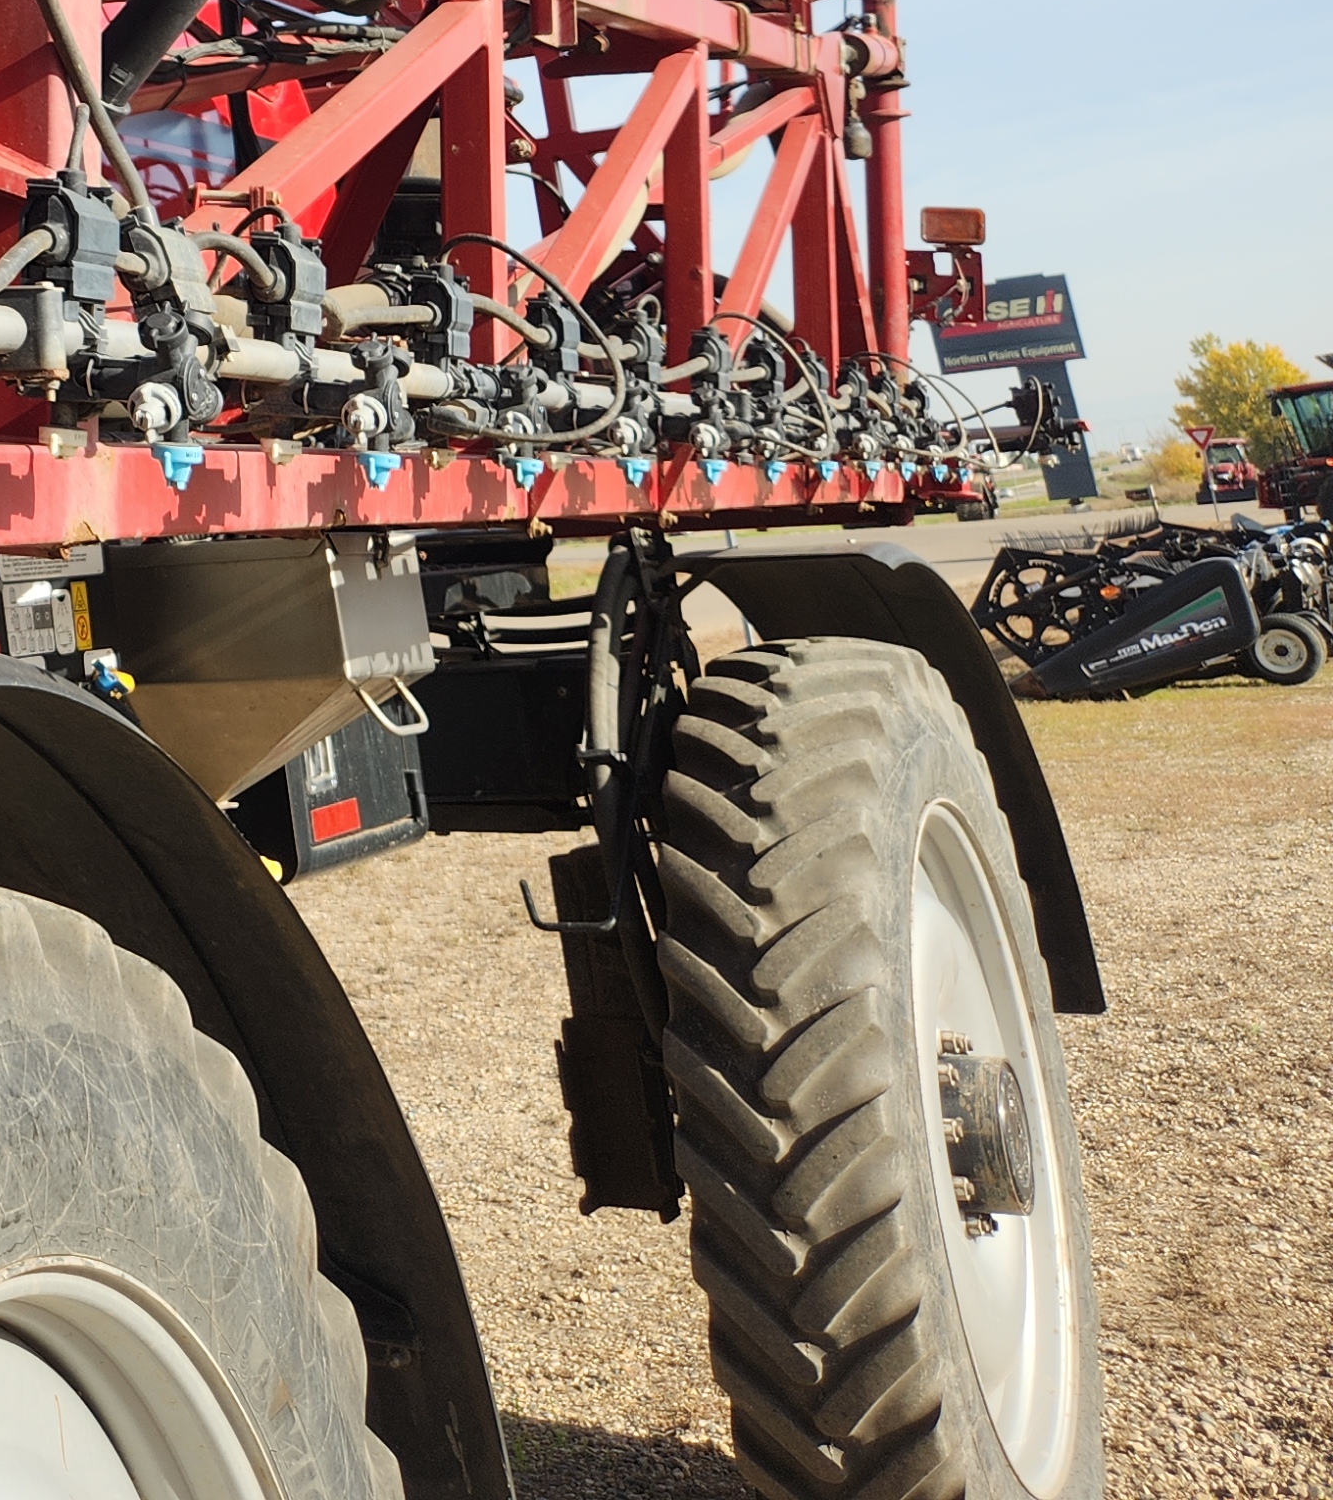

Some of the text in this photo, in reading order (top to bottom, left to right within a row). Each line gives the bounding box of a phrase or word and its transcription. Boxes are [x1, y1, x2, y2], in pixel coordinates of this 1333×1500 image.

[987, 297, 1031, 321] SE
[997, 314, 1062, 330] AGRICULTURE
[943, 342, 1076, 368] Northern Plains Equipment
[1139, 615, 1227, 652] MacDon
